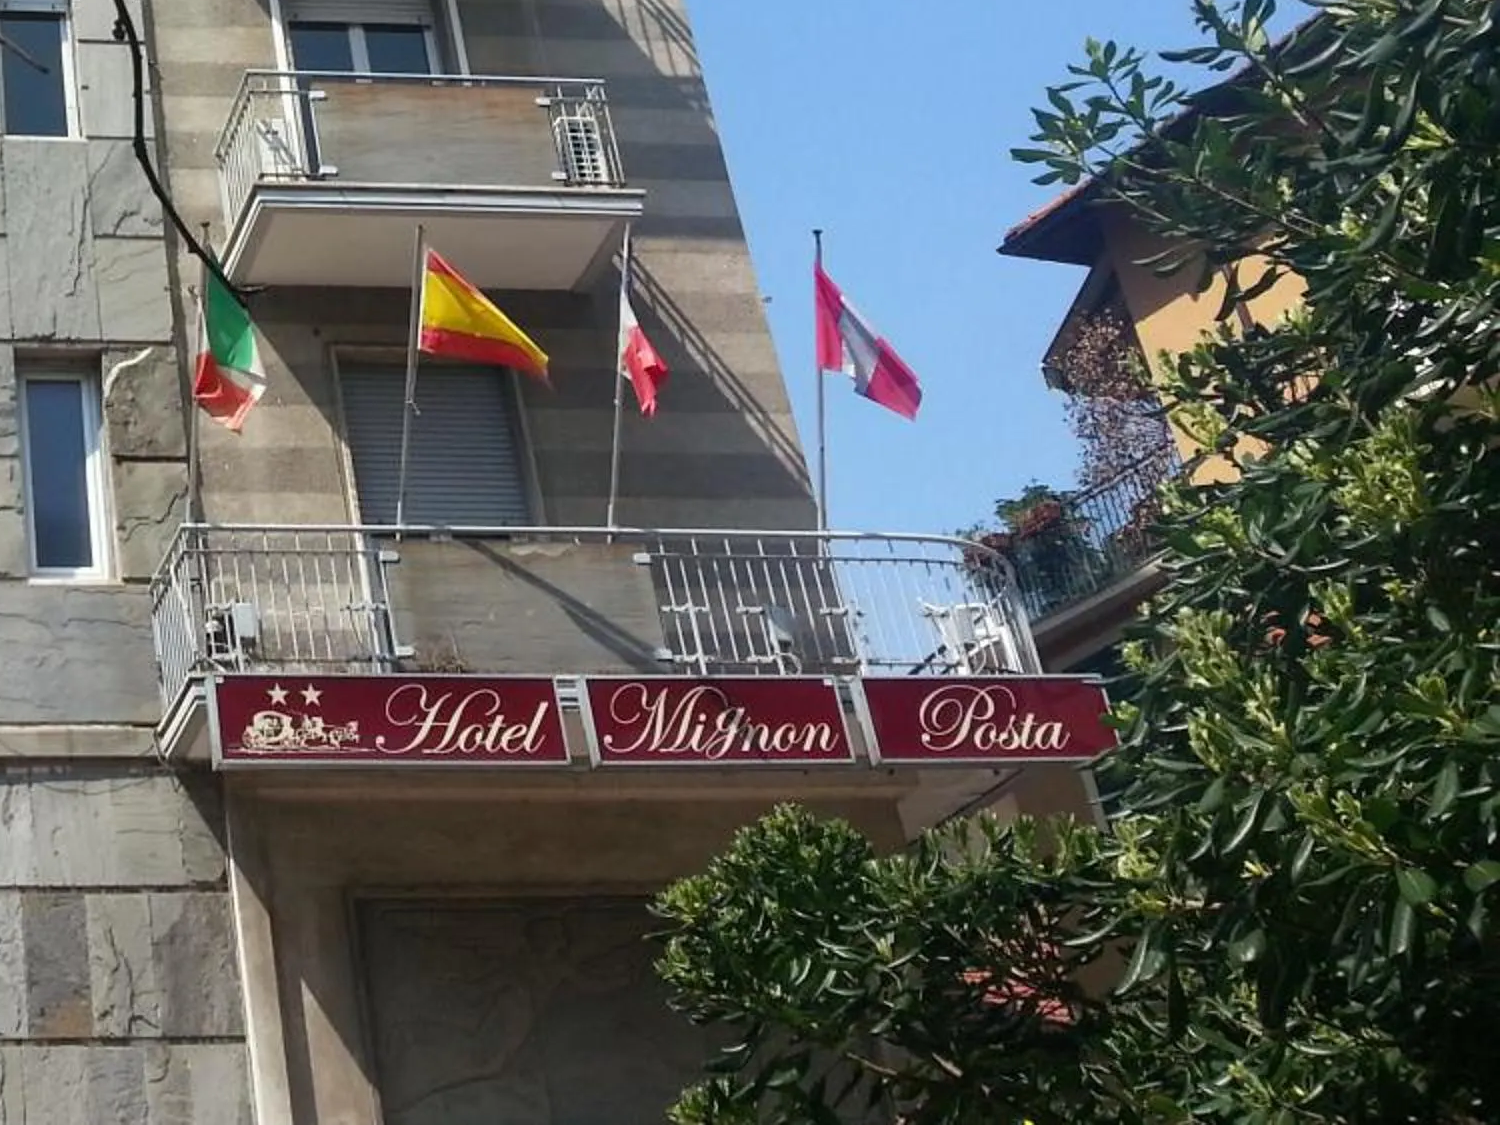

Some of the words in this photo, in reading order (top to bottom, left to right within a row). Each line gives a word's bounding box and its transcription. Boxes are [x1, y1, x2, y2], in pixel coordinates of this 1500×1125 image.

[375, 684, 548, 754] Hotel
[603, 684, 839, 759] Mignon
[919, 685, 1070, 751] Posta
